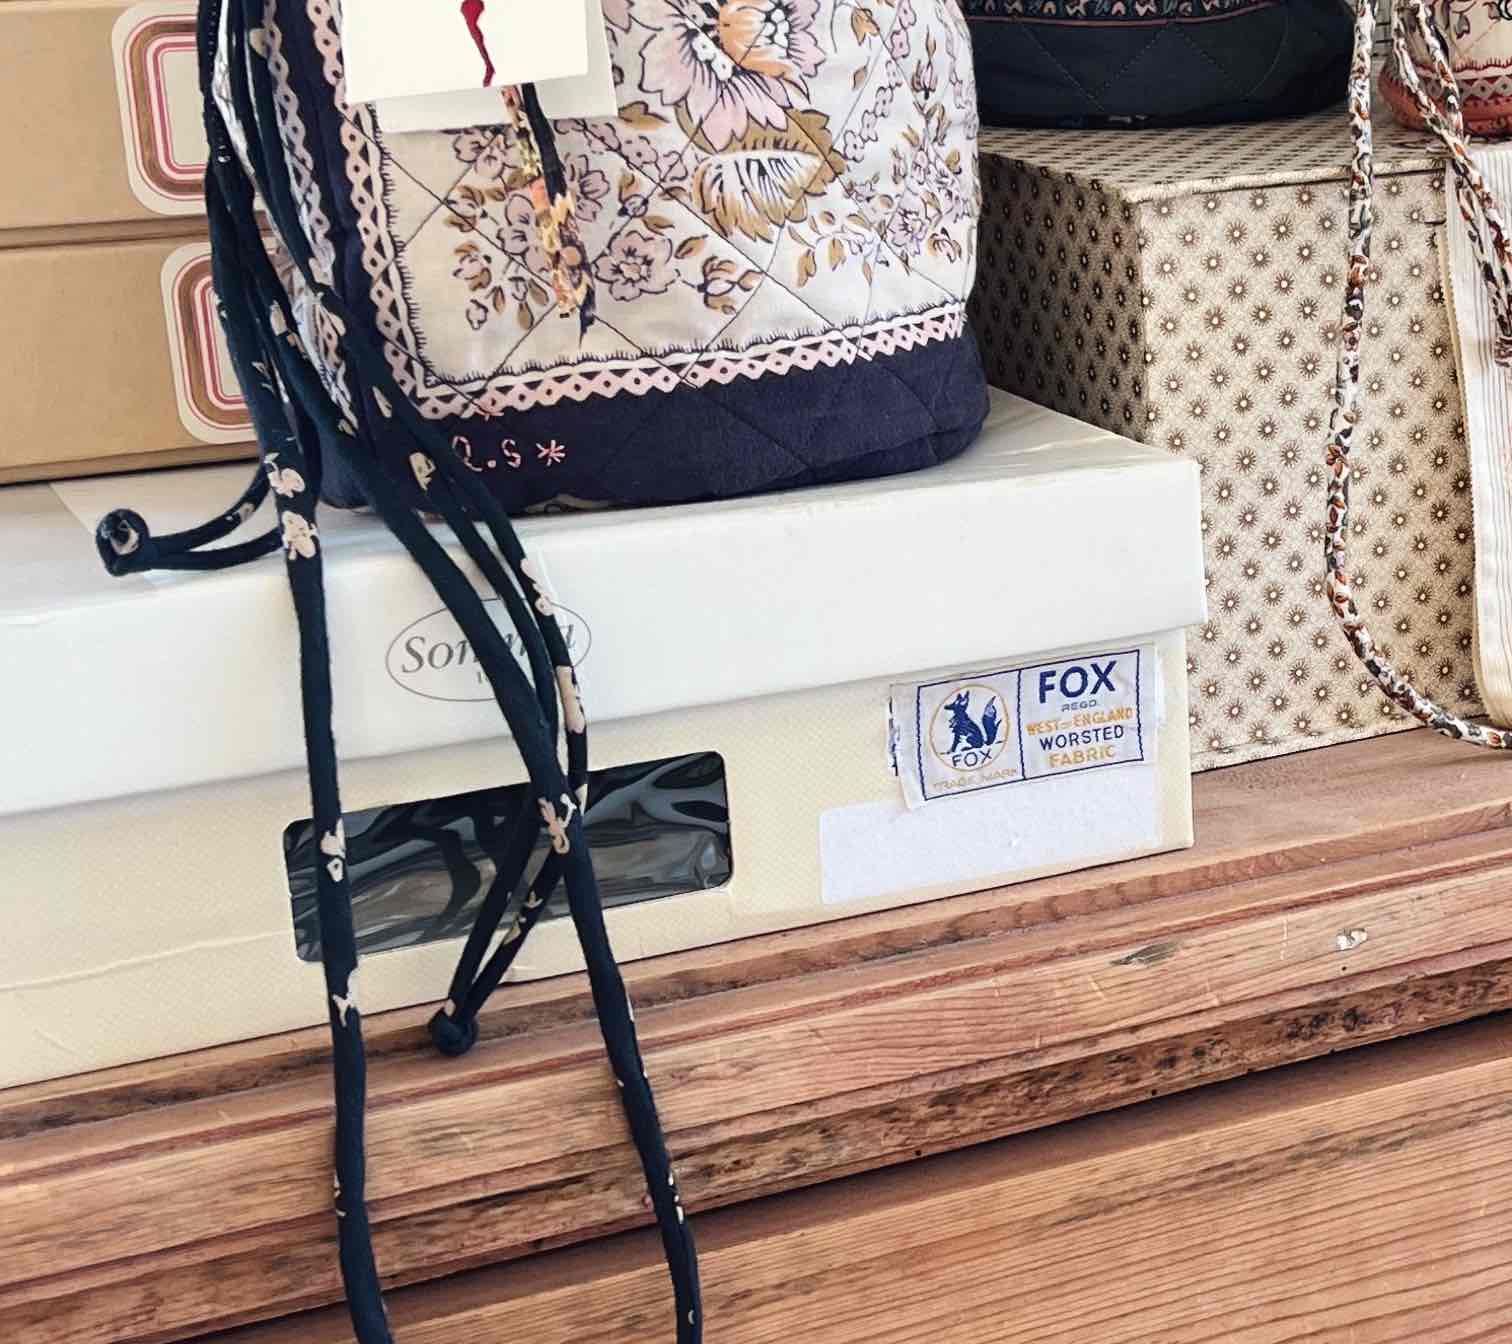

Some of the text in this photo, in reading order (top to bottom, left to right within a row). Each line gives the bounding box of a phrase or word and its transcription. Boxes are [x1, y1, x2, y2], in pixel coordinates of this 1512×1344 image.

[1039, 659, 1118, 704] FOX
[1025, 719, 1059, 736] WEST
[1072, 706, 1134, 729] ENGLAND
[1039, 724, 1125, 752] WORSTED
[951, 747, 993, 768] FOX
[1048, 744, 1118, 769] FABRIC
